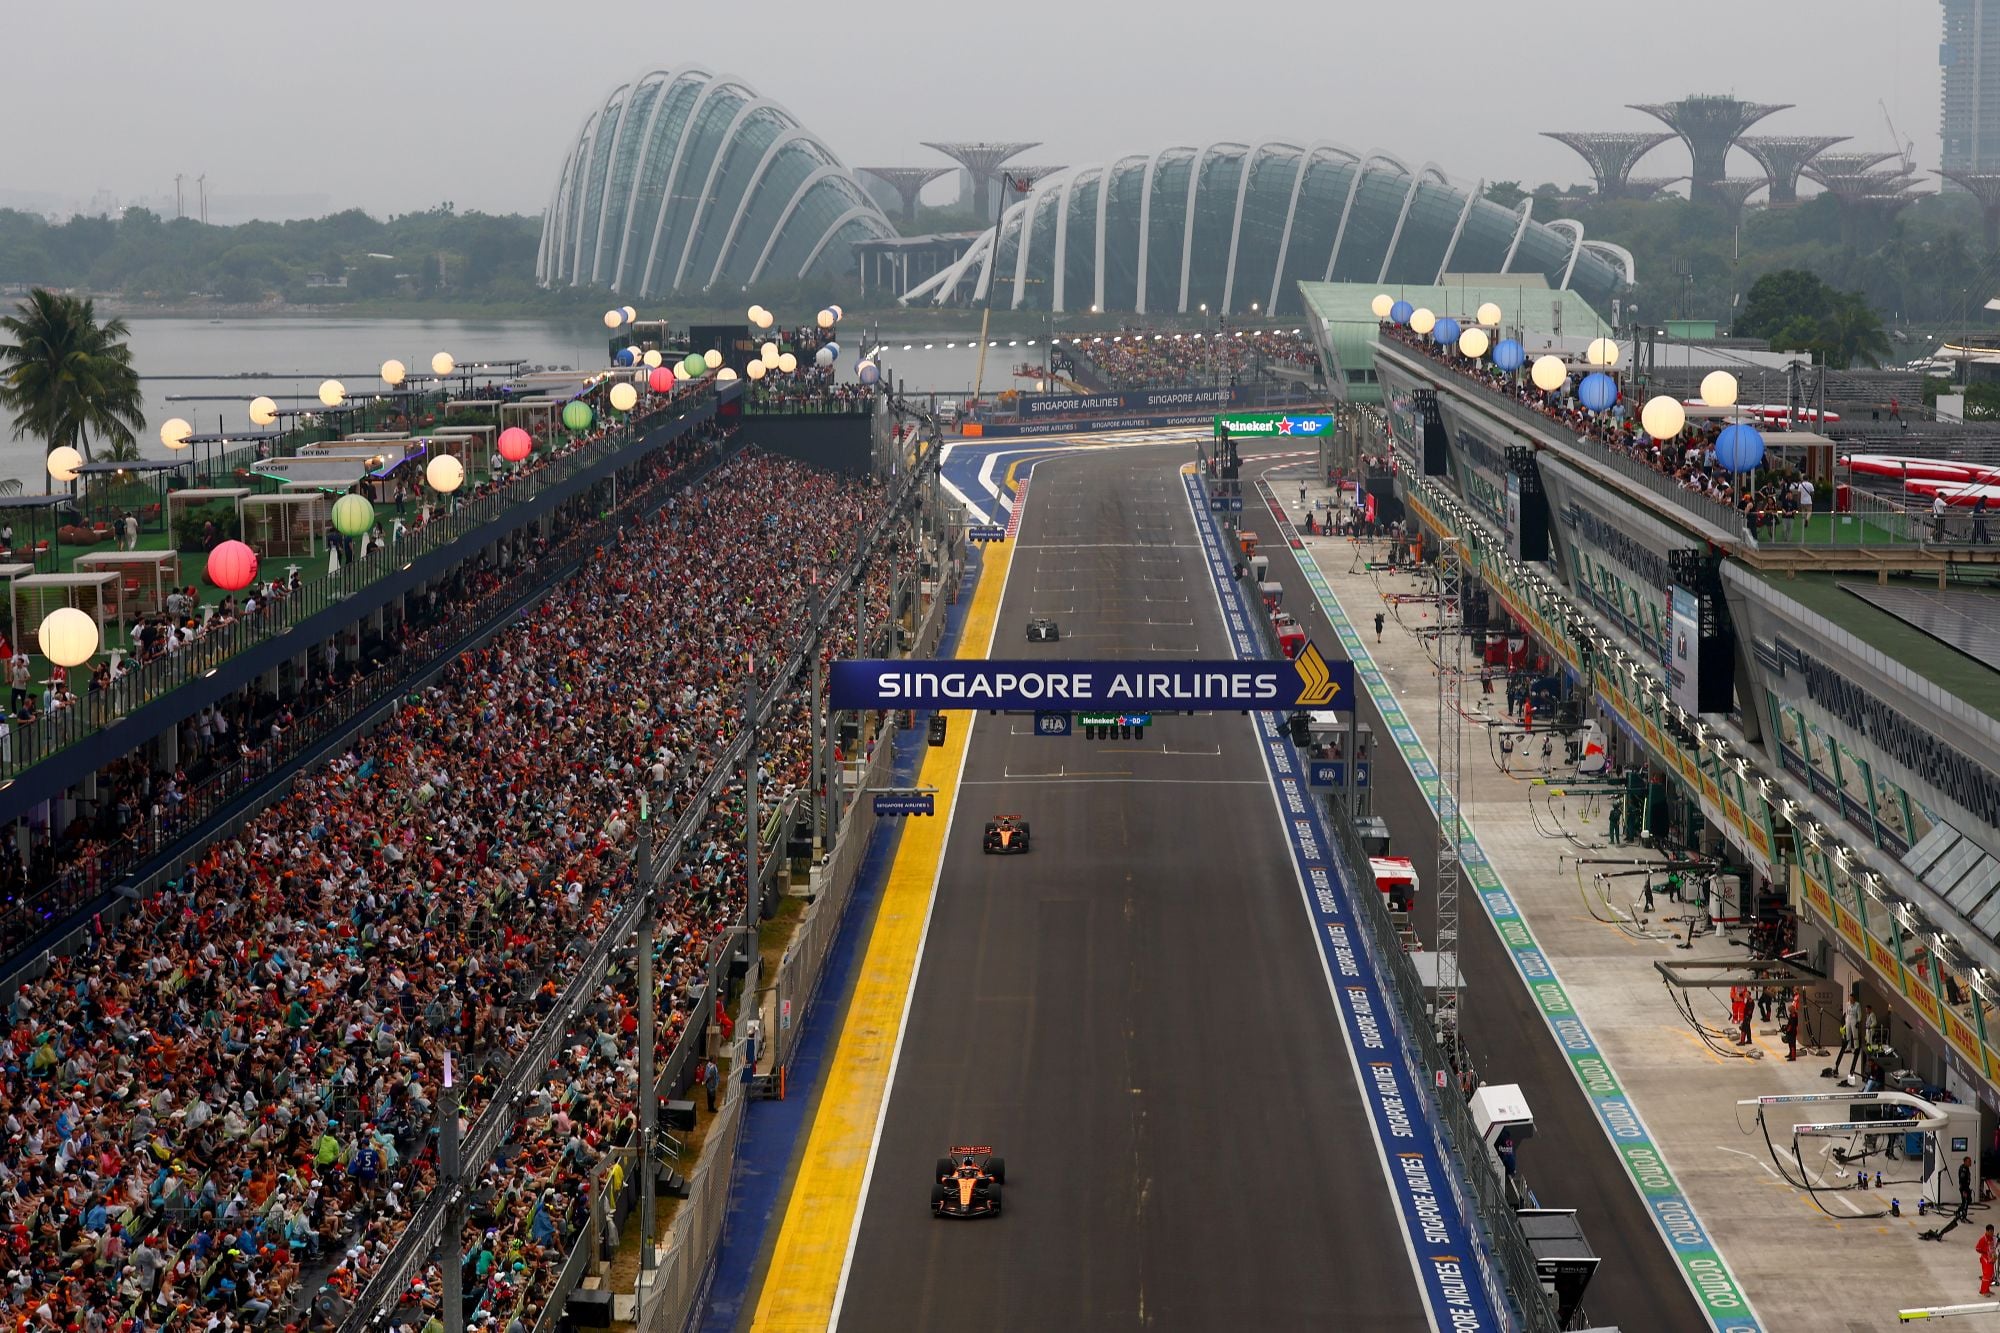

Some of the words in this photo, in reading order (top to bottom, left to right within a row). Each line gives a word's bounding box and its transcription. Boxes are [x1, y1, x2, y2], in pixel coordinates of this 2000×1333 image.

[1031, 401, 1078, 412] SINGAPORE
[1081, 398, 1118, 407] AIRLINES
[1148, 394, 1192, 405] SINGAPORE
[878, 673, 1092, 699] SINGAPORE
[1107, 674, 1277, 698] AIRLINES
[1042, 717, 1064, 730] FIA
[1319, 769, 1335, 779] FIA
[1842, 917, 1861, 946] DHL
[1876, 948, 1896, 976] DHL
[1914, 982, 1934, 1013] DHL
[1954, 1021, 1978, 1055] DHL
[1372, 1066, 1400, 1097] AIRLINES
[1578, 1059, 1615, 1092] aramco
[1382, 1096, 1414, 1138] SINGAPORE
[1601, 1102, 1641, 1137] aramco
[365, 1155, 371, 1167] 5
[1401, 1157, 1435, 1195] AIRLINES
[1627, 1149, 1671, 1188] aramco
[1413, 1194, 1450, 1244] SINGAPORE
[1656, 1201, 1703, 1244] aramco
[1434, 1261, 1473, 1307] AIRLINES
[1689, 1259, 1740, 1308] aramco
